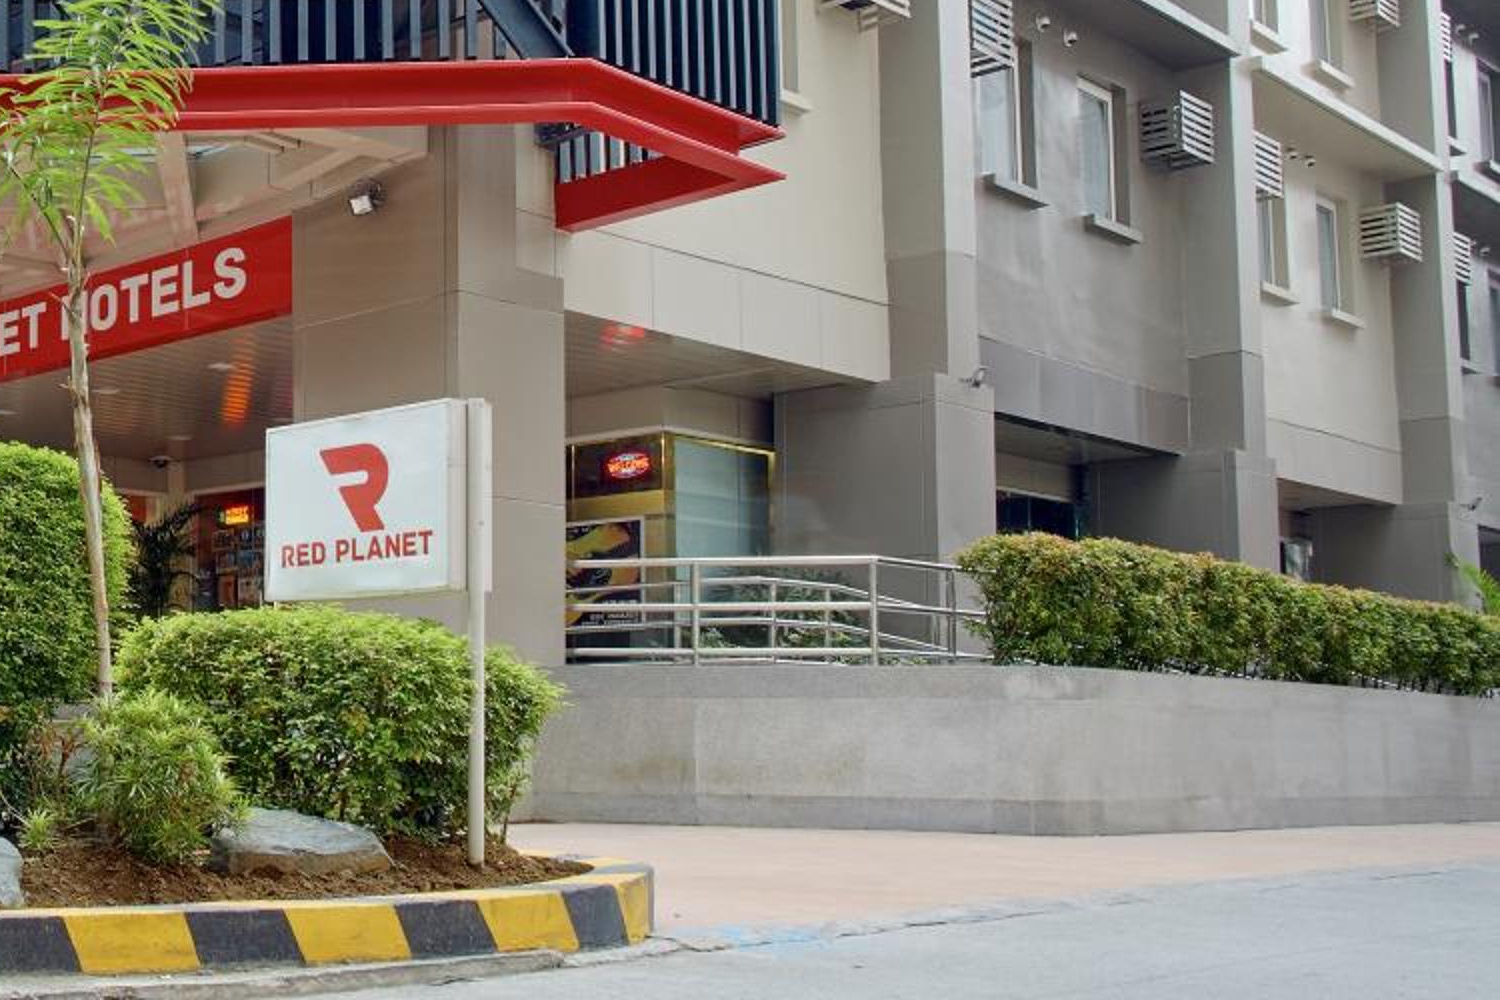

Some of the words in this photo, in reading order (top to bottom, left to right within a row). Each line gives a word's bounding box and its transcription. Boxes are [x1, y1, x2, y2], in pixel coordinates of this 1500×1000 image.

[319, 443, 389, 533] R
[281, 541, 326, 568] RED
[335, 530, 433, 563] PLANET
